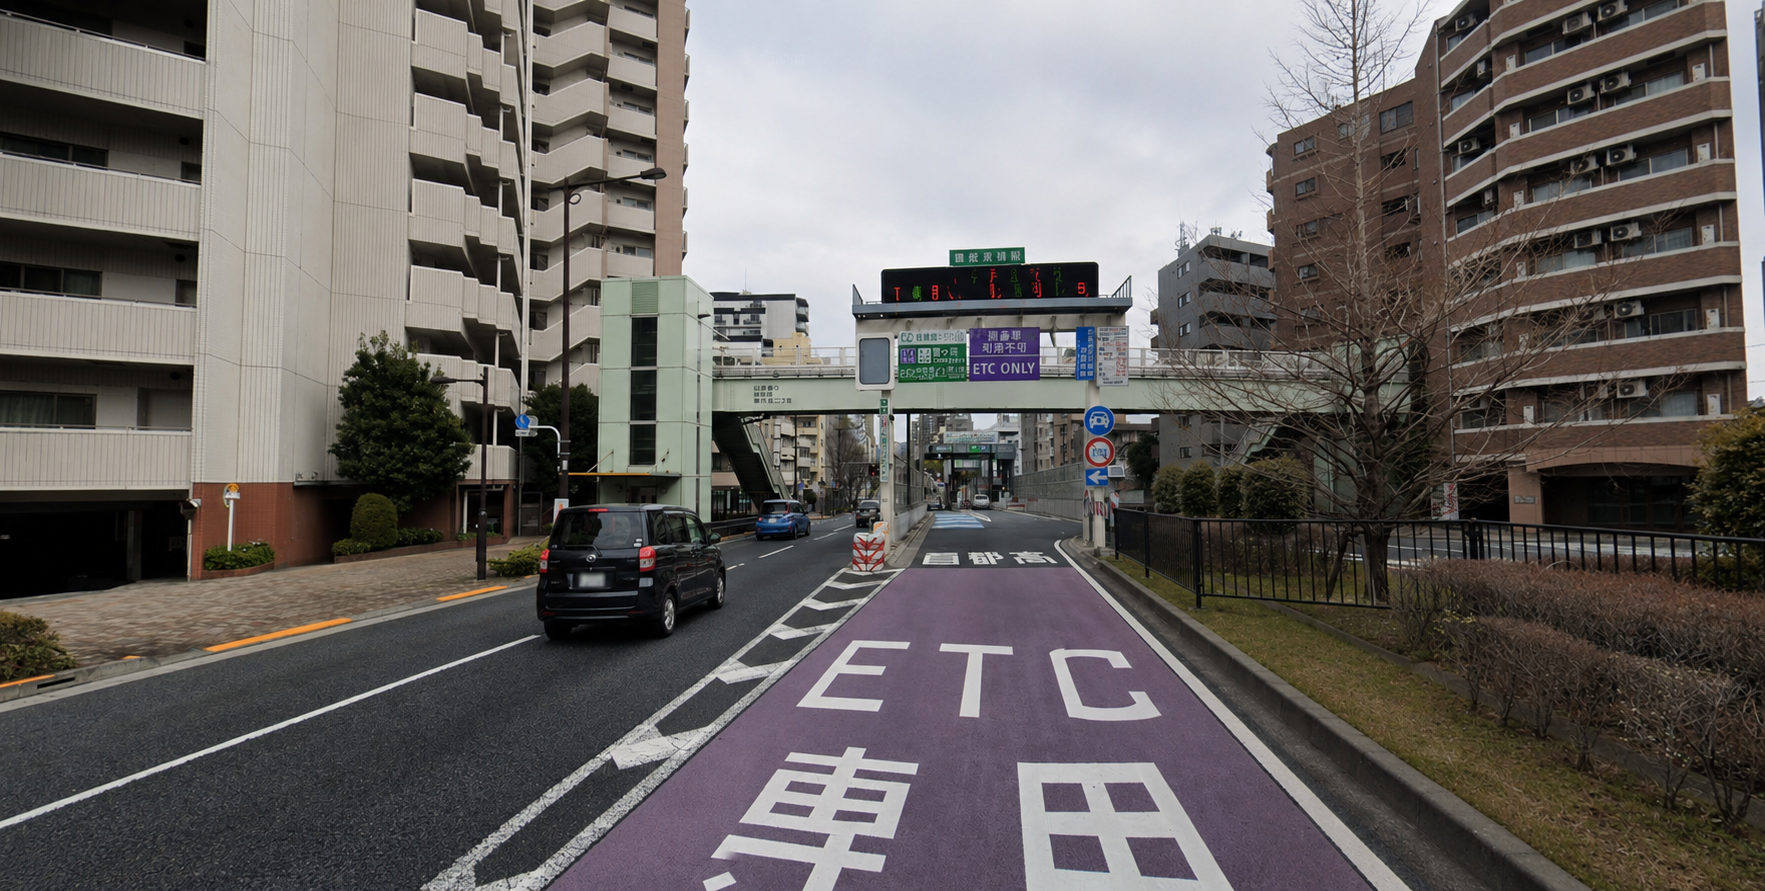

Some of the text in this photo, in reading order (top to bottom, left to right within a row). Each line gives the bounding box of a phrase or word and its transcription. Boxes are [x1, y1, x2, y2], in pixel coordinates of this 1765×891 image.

[973, 362, 996, 375] ETC
[1000, 362, 1035, 375] ONLY
[796, 640, 1162, 722] ETC
